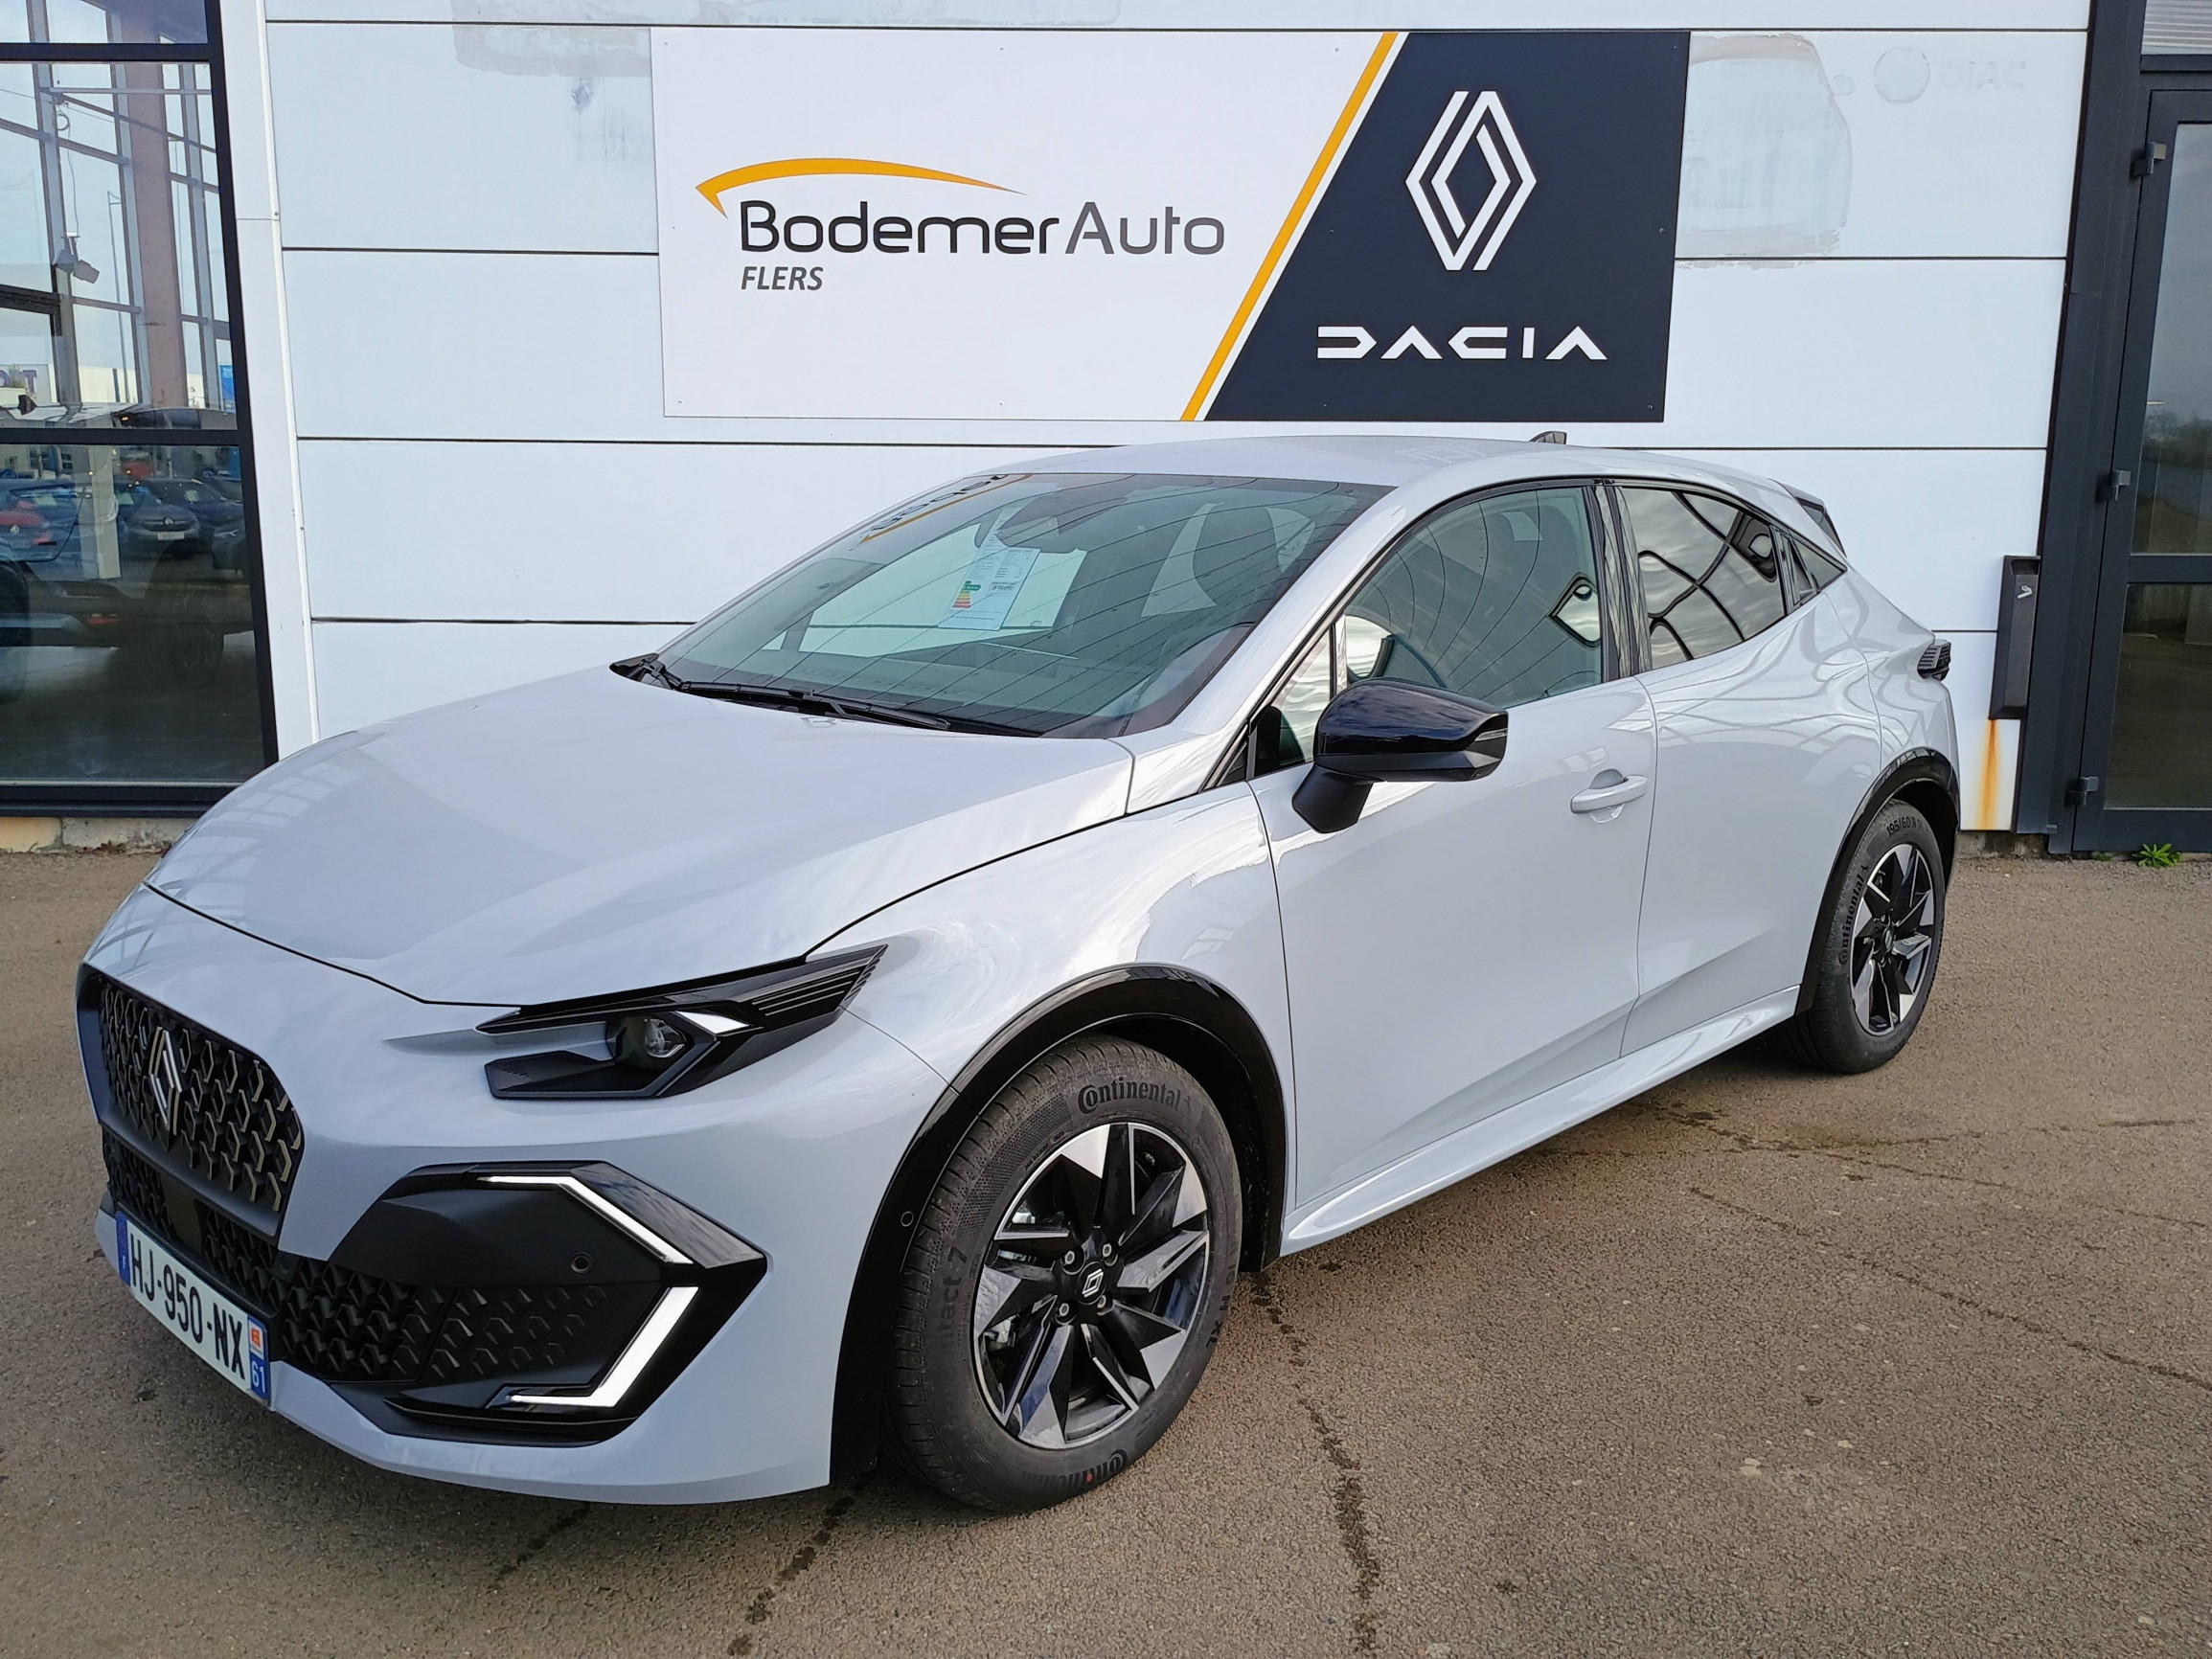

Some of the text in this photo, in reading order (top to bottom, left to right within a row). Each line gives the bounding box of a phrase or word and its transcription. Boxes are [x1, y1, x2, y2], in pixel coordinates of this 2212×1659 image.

[741, 266, 824, 291] FLERS
[1316, 325, 1608, 360] DACIA
[1838, 874, 1864, 965] Continental
[1078, 1077, 1181, 1114] Continental
[946, 1246, 968, 1264] 7
[130, 1233, 245, 1380] HJ-950-NX
[251, 1359, 265, 1394] 61
